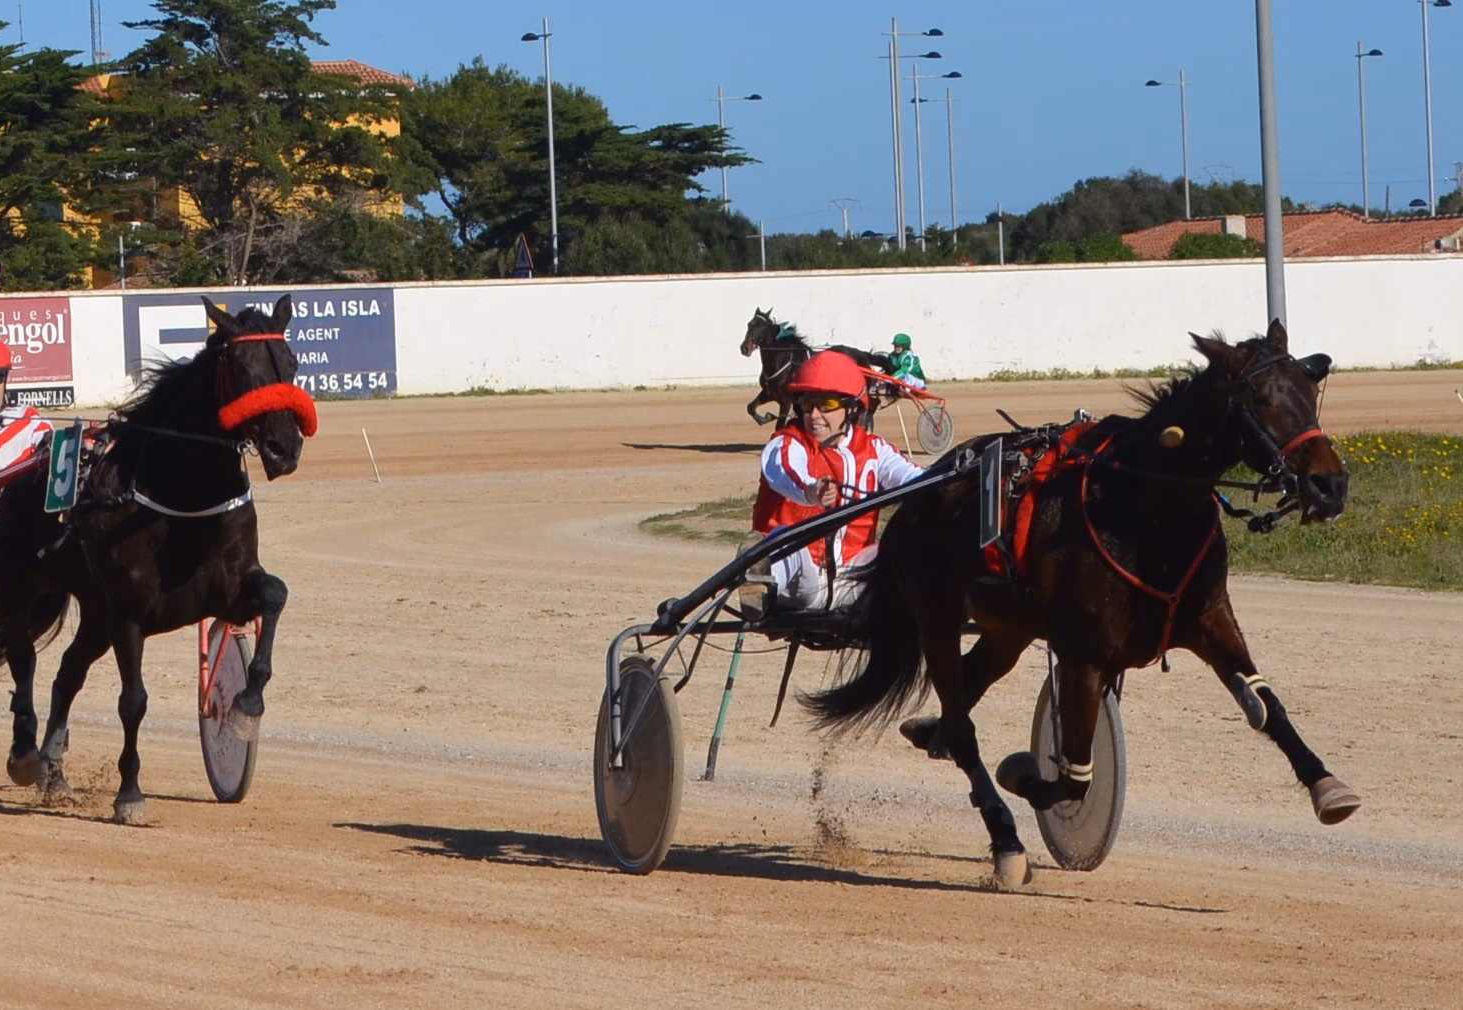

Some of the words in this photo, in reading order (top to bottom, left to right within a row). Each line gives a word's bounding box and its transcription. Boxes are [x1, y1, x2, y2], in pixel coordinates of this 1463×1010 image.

[313, 301, 335, 317] LA
[341, 299, 380, 316] ISLA
[296, 327, 340, 341] AGENT
[319, 374, 339, 391] 36
[343, 373, 363, 390] 54
[368, 371, 388, 389] 54
[17, 389, 72, 407] FORNELLS
